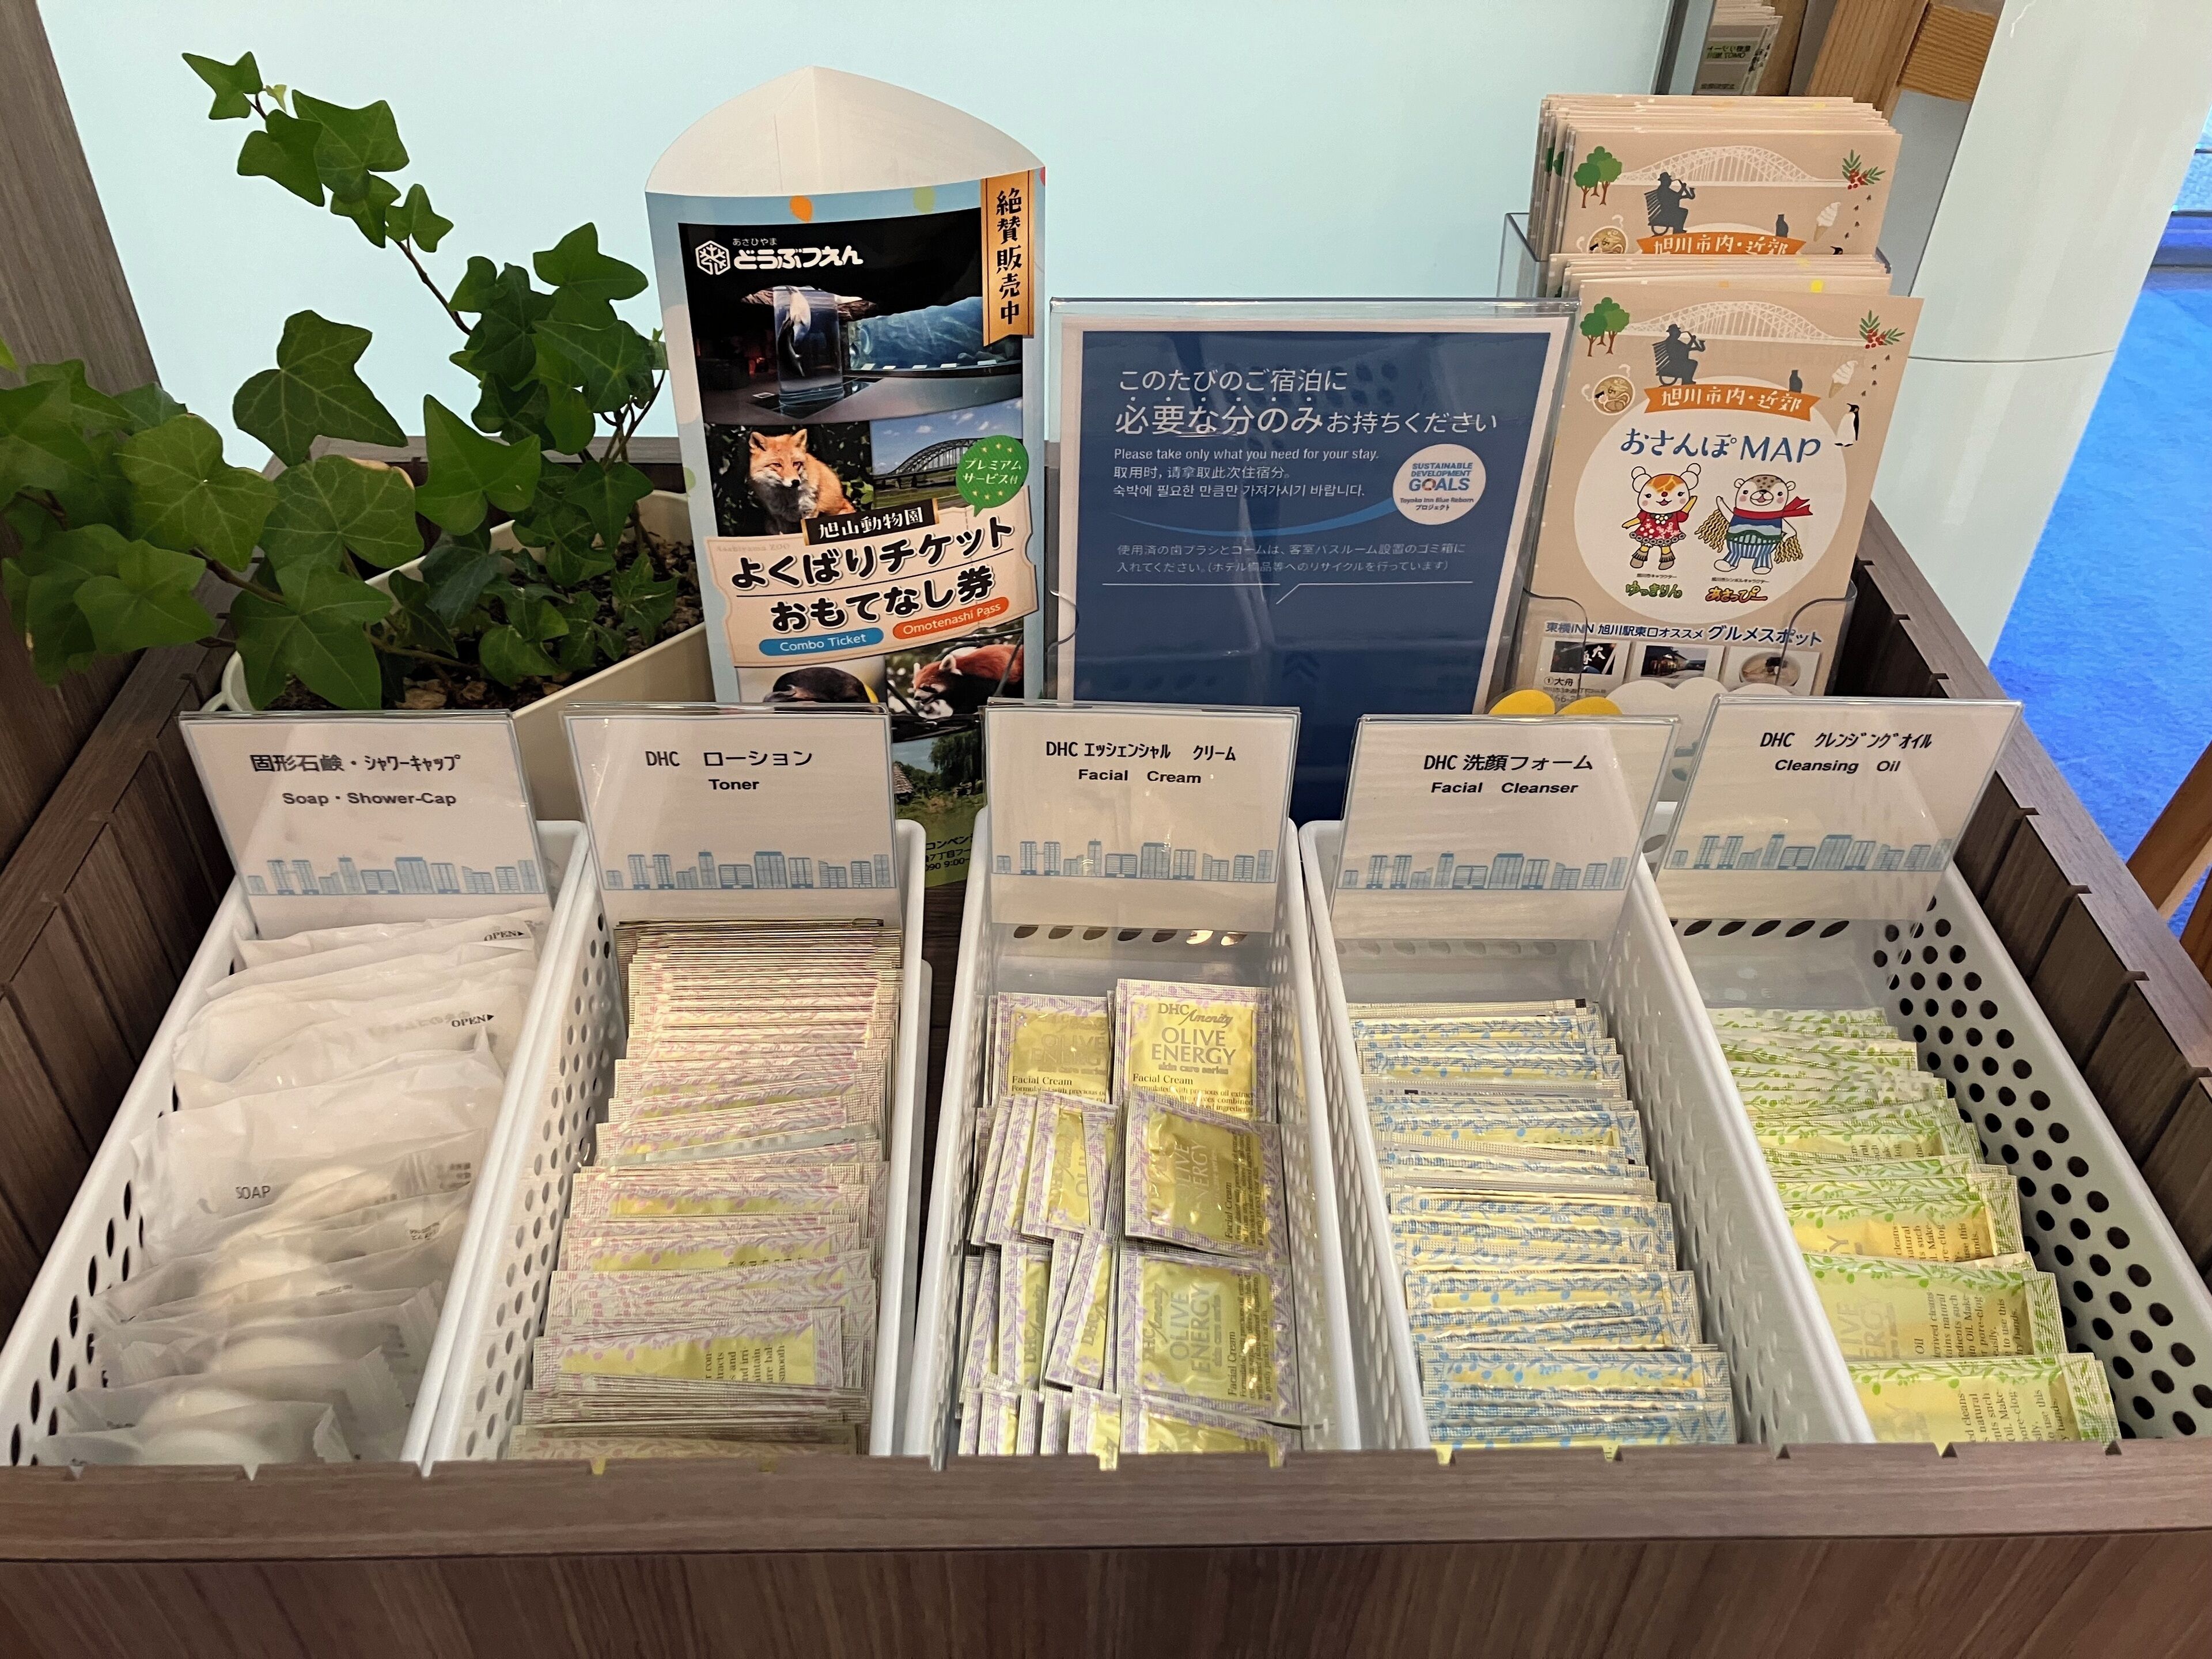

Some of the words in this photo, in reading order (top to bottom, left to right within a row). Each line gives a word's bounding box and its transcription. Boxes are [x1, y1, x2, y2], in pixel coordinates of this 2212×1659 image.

[733, 238, 778, 246] あさひやま
[734, 245, 863, 270] どうぶつえん
[996, 188, 1022, 324] 絶賛販売中
[1119, 369, 1348, 392] このたびのご宿泊に
[1661, 388, 1803, 412] 旭川市内・近郊
[1115, 403, 1498, 435] 必要な分のみお持ちください
[965, 459, 1022, 471] プレミアム
[1114, 449, 1152, 460] Please
[1157, 449, 1183, 460] take
[1185, 449, 1209, 461] only
[1213, 449, 1243, 460] what
[1246, 450, 1267, 461] you
[1270, 449, 1300, 460] need
[1303, 449, 1319, 460] for
[1323, 450, 1349, 461] your
[1351, 449, 1379, 461] stay.
[963, 472, 1018, 485] サービス付
[1409, 478, 1470, 491] GOALS
[1113, 484, 1152, 497] 숙박에
[1157, 484, 1195, 497] 필요한
[1199, 484, 1238, 497] 만큼만
[1243, 484, 1306, 497] 가져가시기
[1310, 484, 1365, 497] 바랍니다.
[819, 506, 924, 539] 旭山動物園
[731, 516, 1014, 589] よくばりチケット
[770, 565, 995, 633] おもてなし券
[903, 609, 974, 635] Omotenashi
[976, 602, 1002, 619] Pass
[779, 637, 825, 652] Combo
[830, 632, 867, 647] Ticket
[1760, 732, 1795, 747] DHC
[645, 751, 680, 767] DHC
[703, 750, 813, 766] ローション
[1046, 741, 1078, 757] DHC
[1193, 745, 1236, 761] クリーム
[1423, 755, 1459, 771] DHC
[1463, 754, 1593, 771] 洗顔フォーム
[1775, 760, 1859, 774] Cleansing
[1876, 760, 1901, 772] Oil
[708, 779, 760, 790] Toner
[1078, 769, 1128, 781] Facial
[1147, 771, 1202, 783] Cream
[1430, 782, 1483, 793] Facial
[1501, 782, 1578, 793] Cleanser
[484, 930, 517, 941] OPEN
[452, 1014, 486, 1027] OPEN
[1158, 1003, 1189, 1015] DHC
[1178, 1009, 1233, 1028] Amenity
[1162, 1027, 1225, 1047] OLIVE
[1152, 1044, 1236, 1065] ENERGY
[1012, 1075, 1039, 1084] Facial
[1043, 1076, 1072, 1085] Cream
[1133, 1073, 1160, 1083] Facial
[1164, 1075, 1194, 1085] Cream
[236, 1185, 271, 1200] SOAP
[1225, 1182, 1233, 1209] Cream
[1914, 1226, 1924, 1248] such
[1959, 1223, 1969, 1239] this
[1937, 1294, 1950, 1330] natural
[1949, 1294, 1960, 1318] such
[1998, 1298, 2006, 1316] this
[1170, 1291, 1189, 1360] OLIVE
[1190, 1283, 1210, 1373] ENERGY
[2001, 1319, 2009, 1335] use
[1228, 1331, 1236, 1362] Cream
[1914, 1339, 1924, 1354] Oil
[728, 1351, 736, 1372] and
[1228, 1366, 1237, 1396] Facial
[1982, 1393, 1995, 1418] such
[2033, 1389, 2046, 1408] this
[1969, 1393, 1986, 1433] natural
[2041, 1411, 2051, 1429] use
